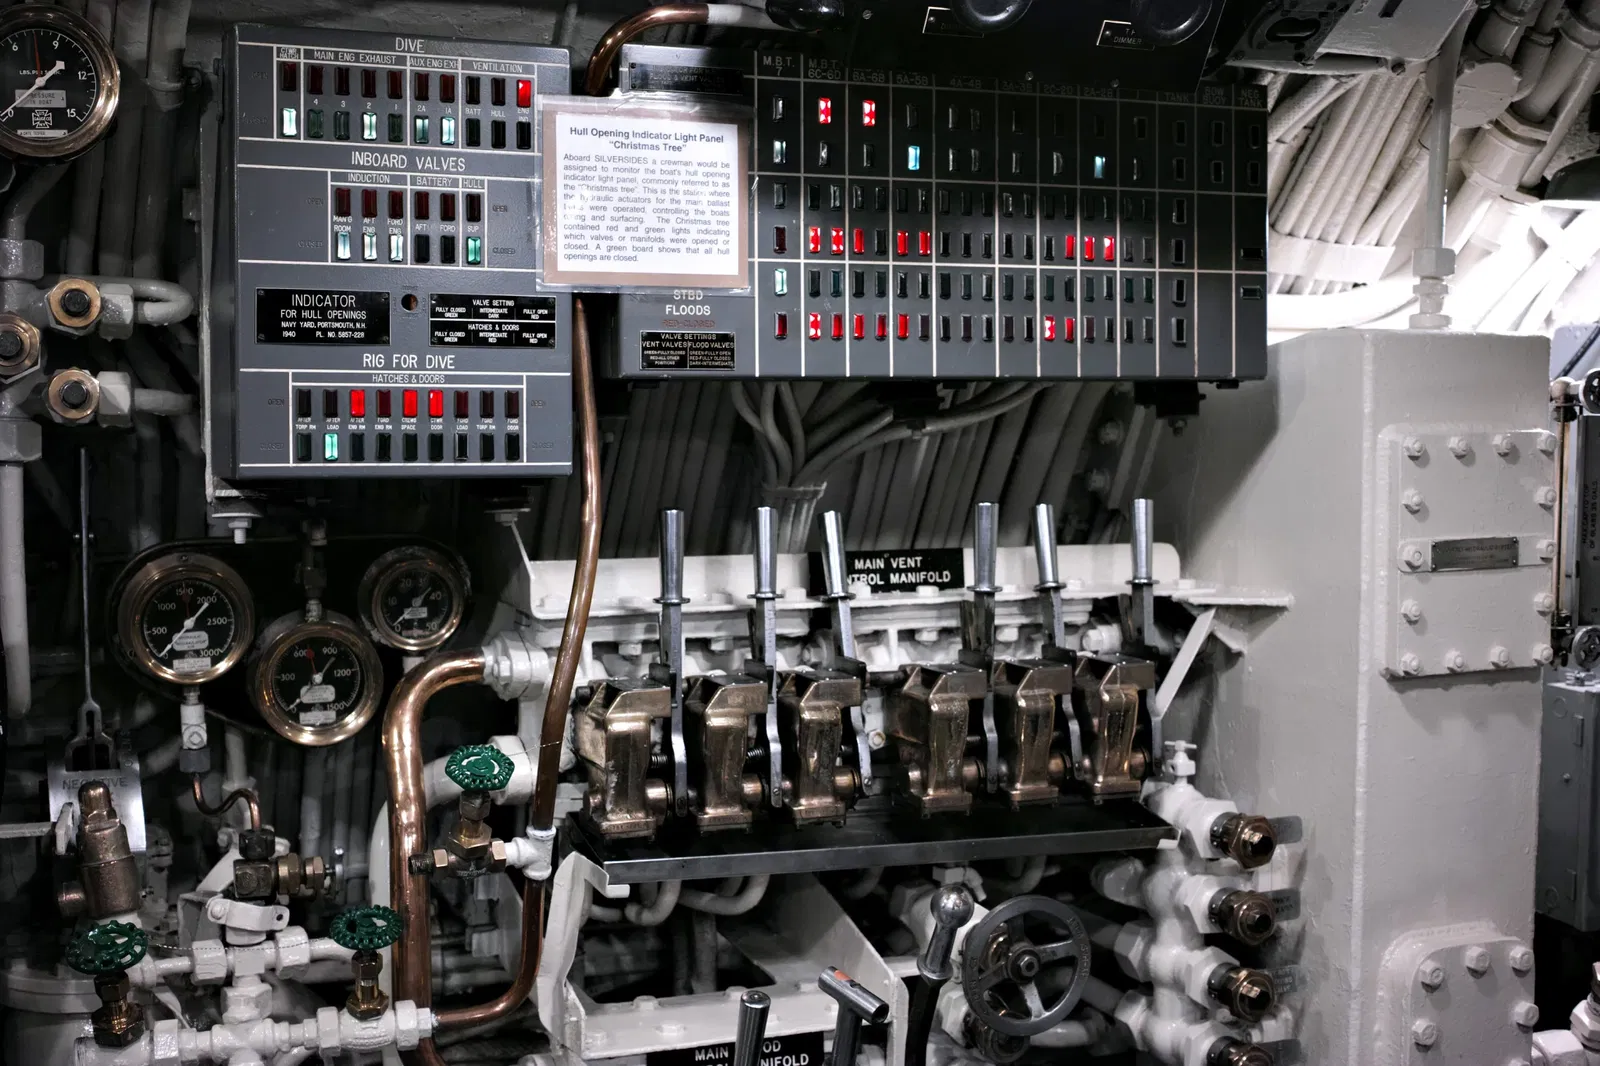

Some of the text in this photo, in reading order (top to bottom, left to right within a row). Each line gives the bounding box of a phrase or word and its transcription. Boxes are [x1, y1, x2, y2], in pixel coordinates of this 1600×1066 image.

[53, 41, 59, 49] 9
[396, 37, 424, 53] DIVE
[314, 51, 396, 64] MAIN ENG EXHAUST
[410, 58, 459, 69] AUX ENG EXH
[473, 62, 522, 73] VENTILATION
[78, 72, 87, 80] 12
[776, 67, 782, 76] 7
[67, 109, 76, 118] 15
[570, 126, 723, 143] Hull Opening Indicator Light Panel
[352, 152, 465, 170] INBOARD VALVES
[563, 153, 590, 162] Aboard
[594, 154, 648, 164] SILVERSIDES
[564, 162, 597, 173] assigned
[599, 165, 608, 173] to
[613, 164, 640, 174] monitor
[685, 168, 698, 176] hull
[702, 170, 730, 179] opening
[348, 174, 390, 183] INDUCTION
[416, 176, 452, 186] BATTERY
[464, 179, 483, 188] HULL
[564, 172, 595, 182] indicator
[598, 174, 614, 184] light
[616, 176, 638, 184] panel,
[642, 176, 678, 186] commonly
[682, 178, 709, 188] referred
[722, 180, 730, 188] as
[642, 186, 658, 194] This
[669, 187, 680, 196] the
[619, 196, 651, 204] actuators
[613, 205, 646, 214] operated,
[653, 207, 689, 217] controlling
[591, 213, 605, 221] and
[609, 214, 645, 224] surfacing.
[656, 216, 670, 224] The
[675, 216, 711, 225] Christmas
[564, 222, 600, 232] contained
[606, 223, 618, 231] red
[625, 224, 638, 232] and
[672, 226, 690, 235] lights
[696, 227, 730, 236] indicating
[564, 232, 585, 241] which
[590, 233, 614, 241] valves
[630, 234, 665, 243] manifolds
[670, 235, 687, 244] were
[692, 237, 718, 245] opened
[606, 243, 627, 252] green
[632, 244, 653, 252] board
[564, 252, 597, 262] openings
[613, 253, 638, 262] closed.
[292, 294, 355, 307] INDICATOR
[674, 290, 703, 300] STBD
[281, 310, 366, 319] FOR HULL OPENINGS
[666, 305, 711, 315] FLOODS
[363, 354, 455, 369] RIG FOR DIVE
[373, 374, 409, 383] HATCHES
[419, 375, 445, 383] DOORS
[854, 557, 922, 569] MAIN VENT
[890, 571, 950, 584] MANIFOLD
[207, 617, 227, 625] 2500
[152, 627, 167, 635] 500
[695, 1046, 728, 1061] MAIN
